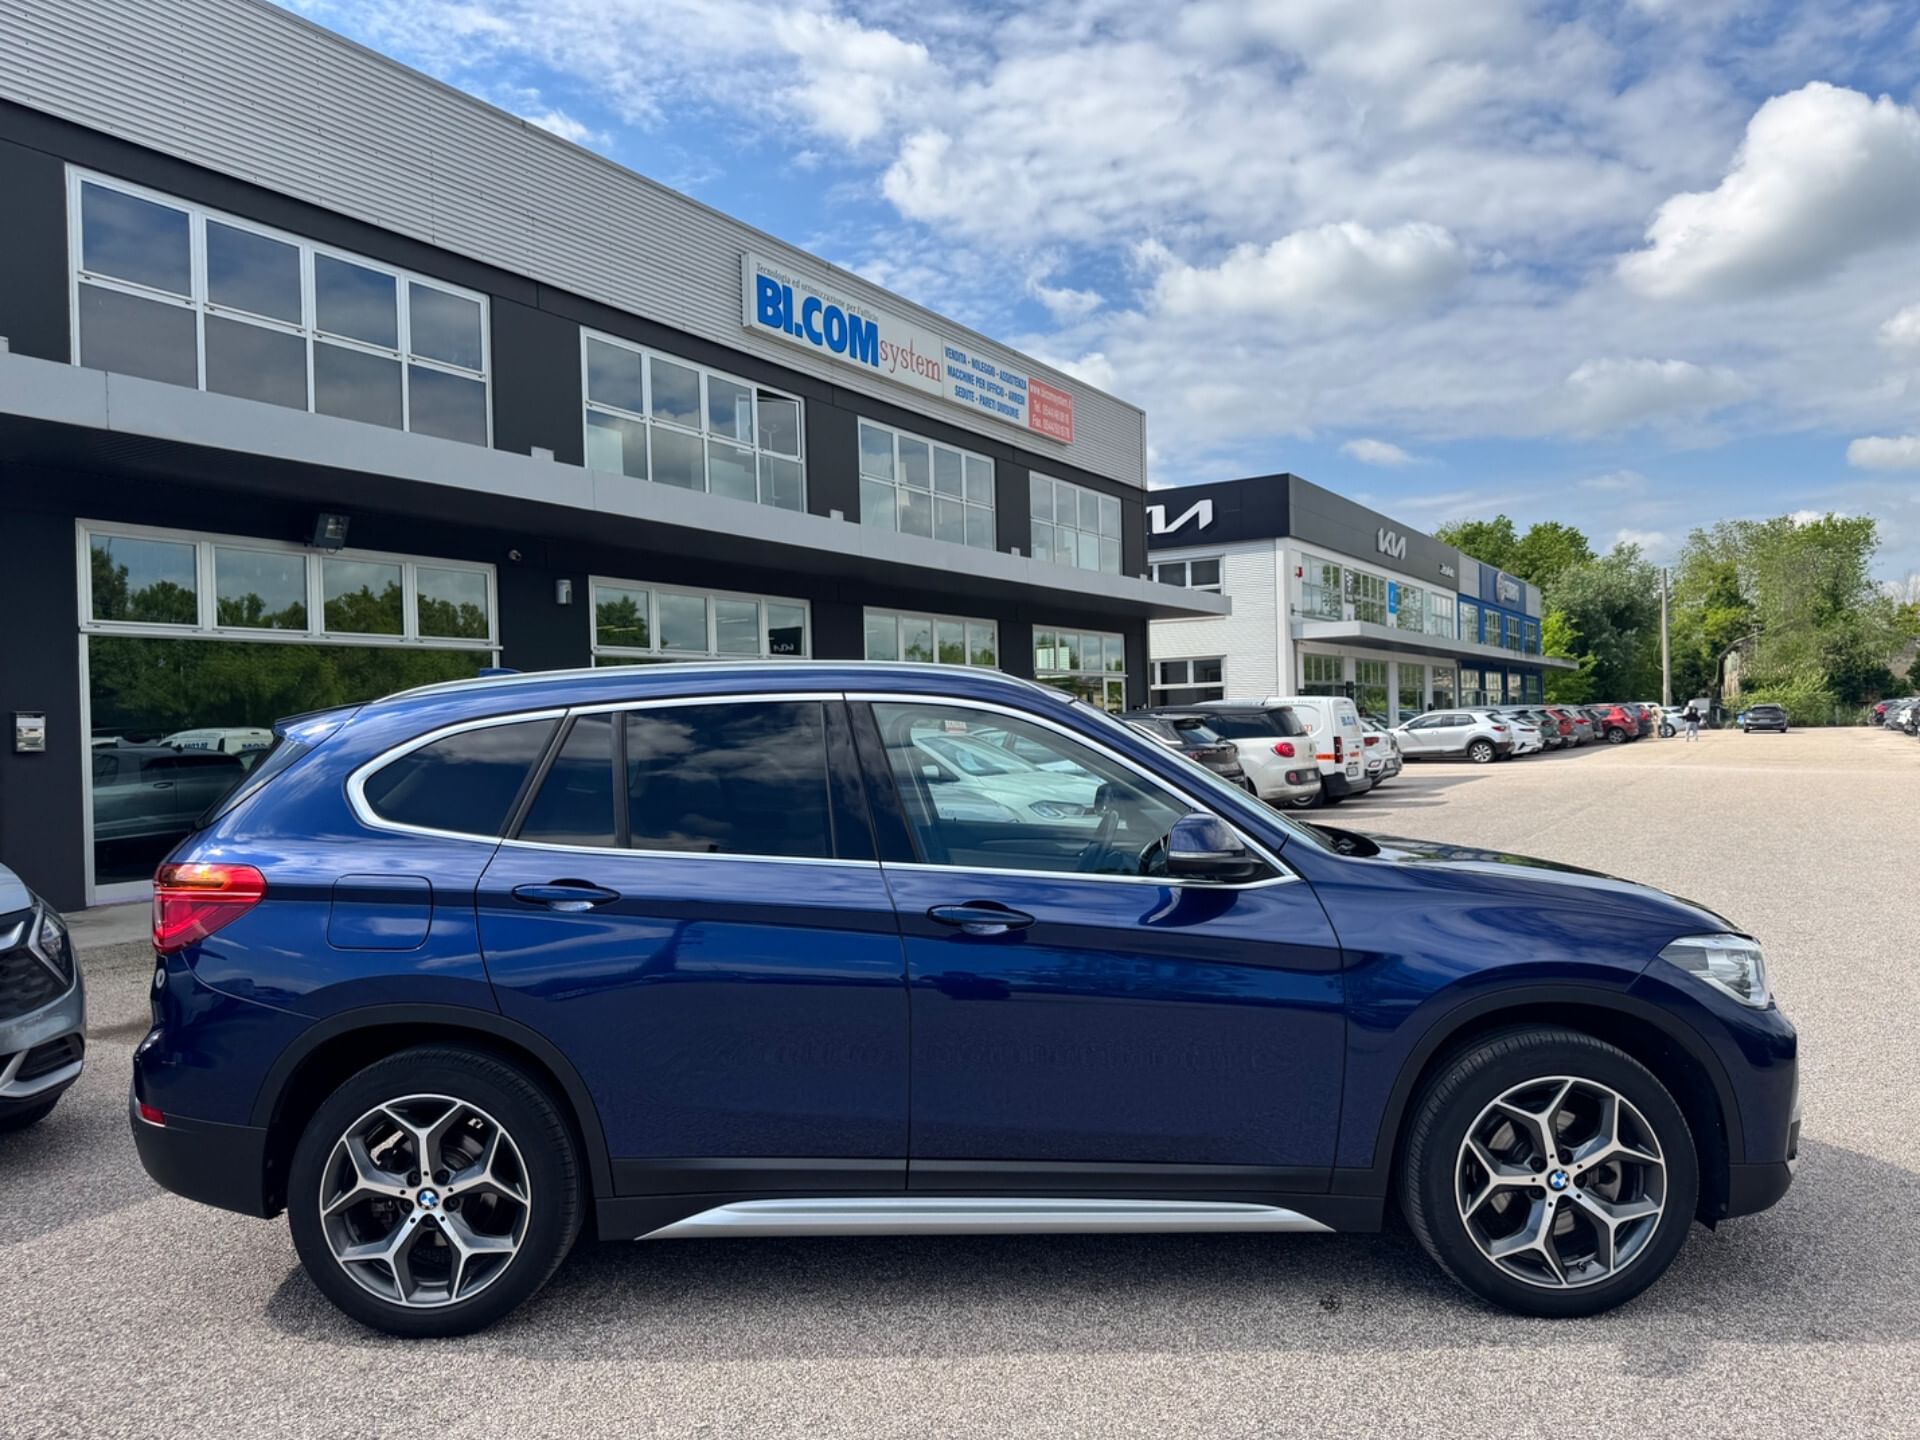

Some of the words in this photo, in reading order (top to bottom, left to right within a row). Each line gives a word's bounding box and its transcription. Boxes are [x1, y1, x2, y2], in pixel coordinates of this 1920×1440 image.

[756, 262, 791, 285] Tecnologia
[756, 273, 879, 368] BI.COM
[880, 336, 941, 382] system
[945, 347, 967, 364] VENDITA
[971, 358, 995, 377] NOLEGGIO
[947, 365, 975, 385] MACCHINE
[976, 376, 985, 390] PER
[987, 381, 1004, 398] UFFICIO
[955, 385, 975, 402] SEDUTE
[979, 394, 996, 410] PARETI
[1145, 499, 1212, 535] IA
[1377, 528, 1406, 560] KIA
